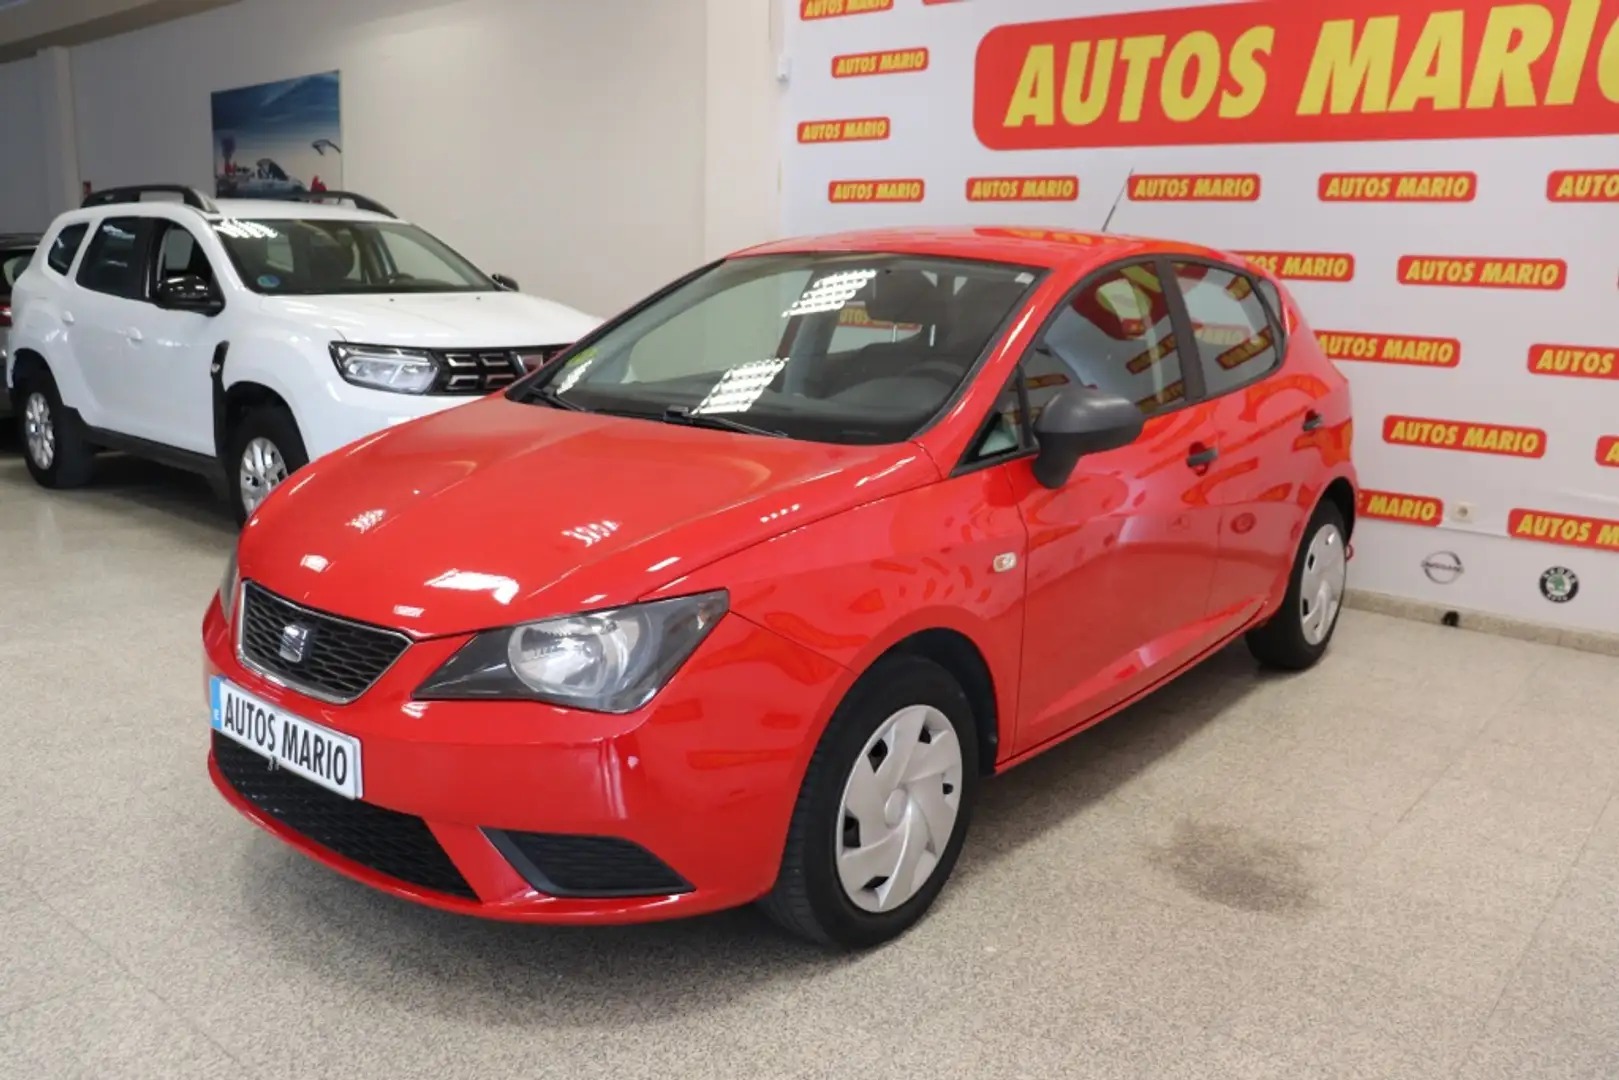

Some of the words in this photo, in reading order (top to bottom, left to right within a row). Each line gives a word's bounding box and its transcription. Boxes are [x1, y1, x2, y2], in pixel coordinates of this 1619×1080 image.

[804, 0, 841, 17] AUTOS
[836, 56, 877, 75] AUTOS
[879, 51, 925, 71] MARIO
[1003, 25, 1275, 127] AUTOS
[802, 123, 840, 140] AUTOS
[843, 120, 887, 139] MARIO
[833, 184, 873, 200] AUTOS
[872, 182, 920, 199] MARIO
[971, 180, 1019, 198] AUTOS
[1022, 180, 1074, 197] MARIO
[1134, 179, 1189, 197] AUTOS
[1193, 178, 1254, 197] MARIO
[1325, 177, 1392, 197] AUTOS
[1396, 176, 1470, 198] MARIO
[1556, 174, 1619, 197] AUTO
[1282, 257, 1348, 277] MARIO
[1406, 260, 1476, 282] AUTOS
[1479, 262, 1559, 285] MARIO
[1382, 339, 1453, 362] MARIO
[1536, 350, 1614, 374] AUTOS
[1391, 422, 1458, 444] AUTOS
[1463, 427, 1538, 452] MARIO
[1368, 496, 1436, 520] MARIO
[1516, 515, 1592, 541] AUTOS
[225, 693, 275, 752] AUTOS
[282, 721, 347, 785] MARIO
